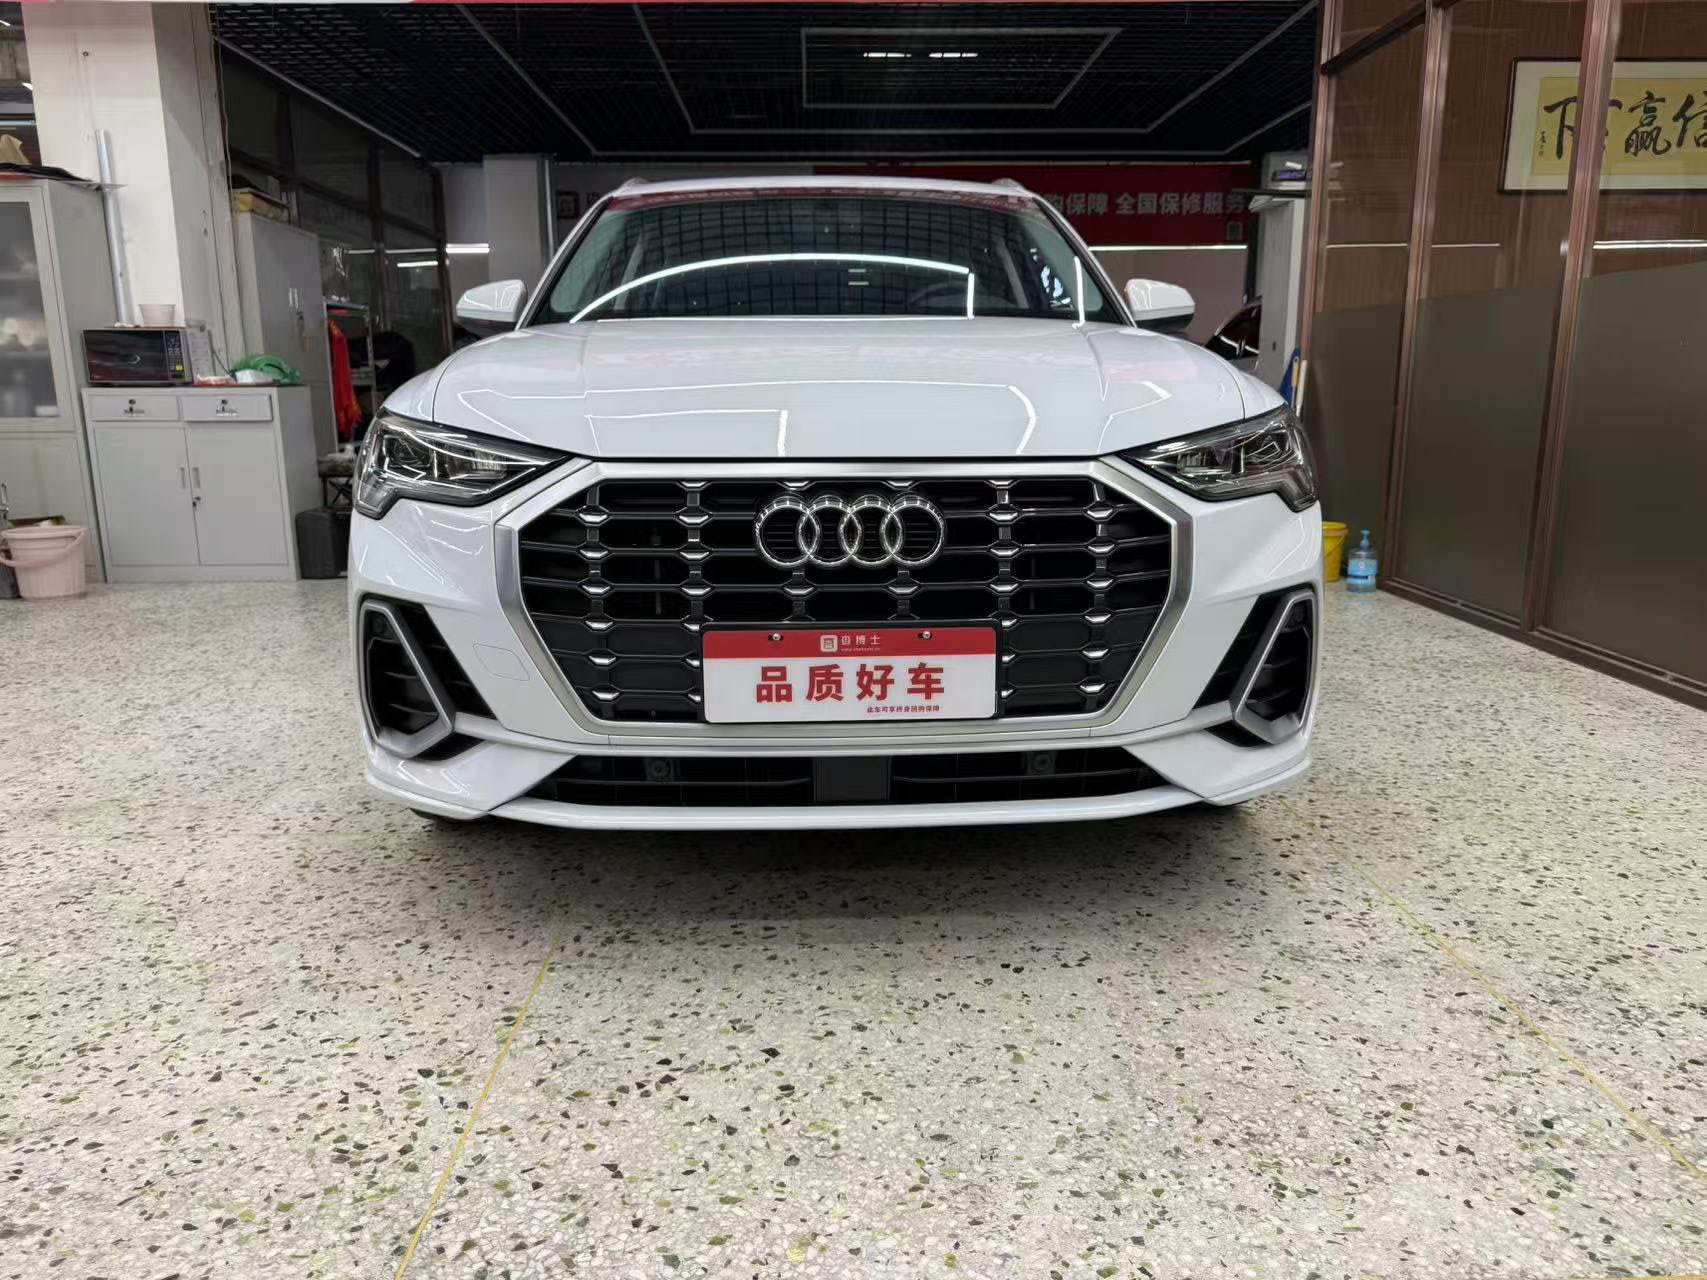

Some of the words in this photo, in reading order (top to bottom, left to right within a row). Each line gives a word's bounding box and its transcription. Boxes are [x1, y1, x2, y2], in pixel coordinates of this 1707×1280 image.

[1115, 192, 1246, 215] 全国保修服务
[756, 662, 945, 703] 品质好车
